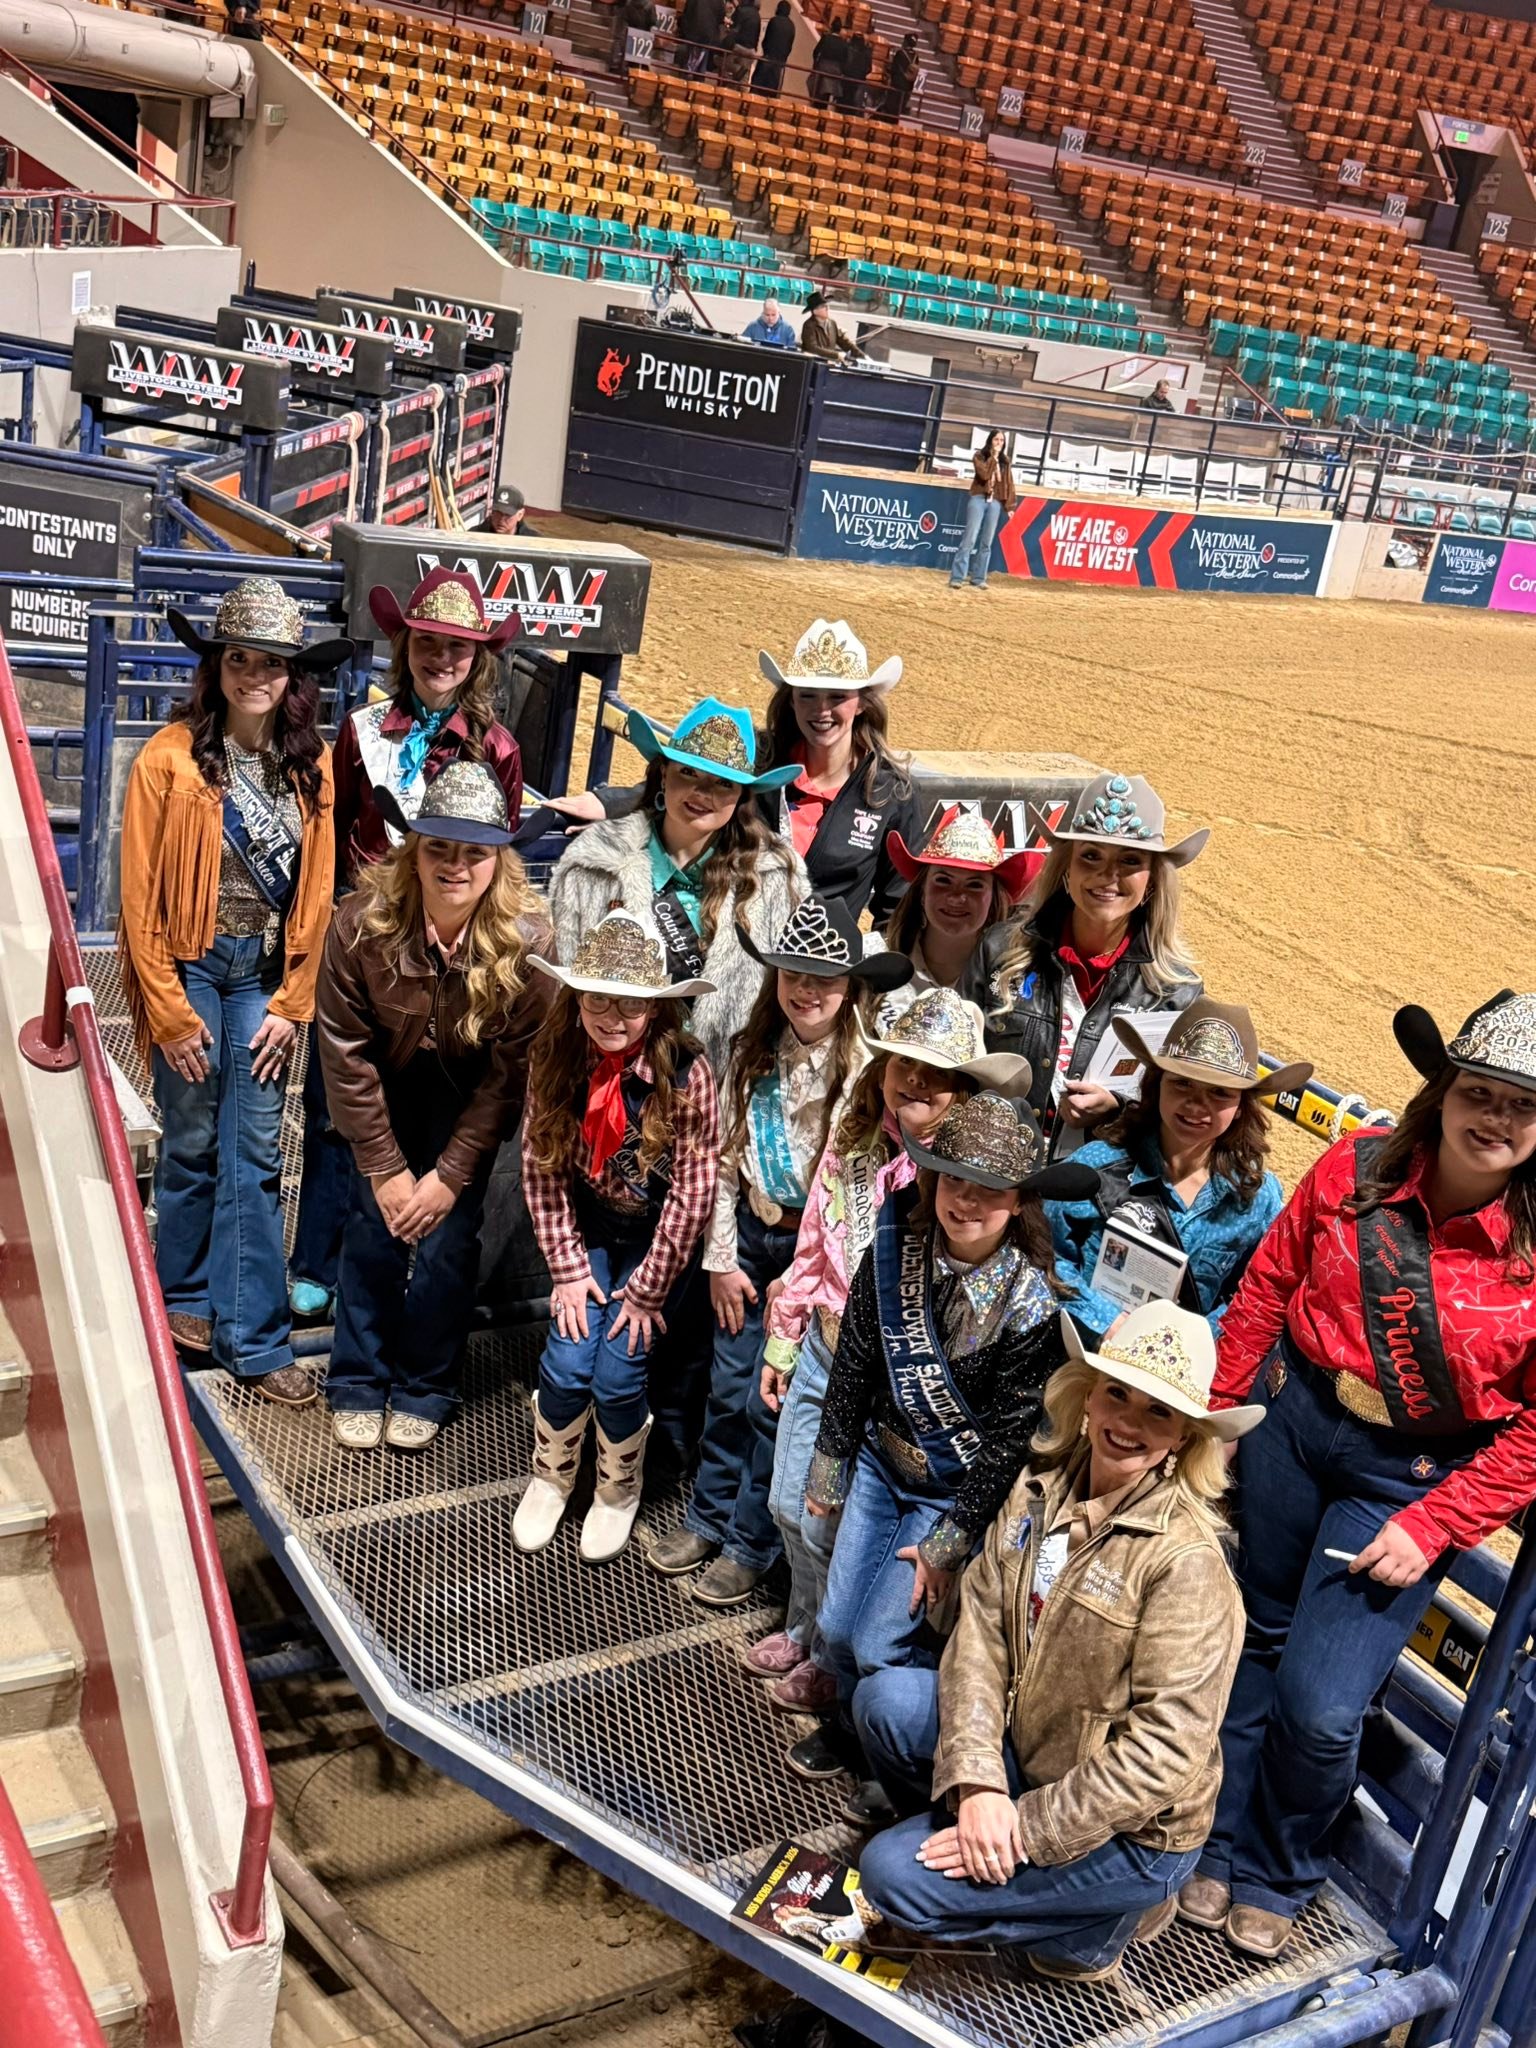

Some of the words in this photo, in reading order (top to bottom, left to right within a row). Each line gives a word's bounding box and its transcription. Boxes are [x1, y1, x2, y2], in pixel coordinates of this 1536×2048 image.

[530, 12, 547, 35] 121
[631, 36, 653, 59] 122
[1001, 93, 1022, 114] 223
[964, 111, 984, 133] 122
[1064, 133, 1085, 153] 123
[1245, 147, 1266, 165] 223
[1341, 166, 1363, 185] 224
[1387, 199, 1407, 218] 123
[1488, 219, 1510, 238] 125
[251, 342, 300, 357] LIVESTOCK
[302, 350, 342, 364] SYSTEMS
[394, 338, 425, 349] YSTEMS
[118, 369, 178, 387] LIVESTOCK
[181, 379, 230, 396] SYSTEMS
[635, 352, 782, 413] PENDLETON
[665, 394, 743, 420] WHISKY
[821, 489, 912, 518] NATIONAL
[0, 505, 117, 544] CONTESTANTS
[835, 512, 919, 541] WESTERN
[1050, 514, 1081, 541] WE
[1079, 517, 1115, 545] ARE
[32, 534, 77, 559] ONLY
[1190, 528, 1257, 551] NATIONAL
[1440, 543, 1485, 560] NATIONAL
[1053, 541, 1087, 567] THE
[1087, 543, 1138, 572] WEST
[1198, 548, 1261, 570] WESTERN
[1446, 556, 1487, 570] WESTERN
[11, 588, 91, 620] NUMBERS
[516, 603, 585, 618] SYSTEMS
[10, 611, 89, 641] REQUIRED
[655, 902, 689, 952] County
[1278, 1091, 1300, 1112] CAT
[851, 1154, 870, 1243] Crusaders
[1379, 1286, 1435, 1420] Princess
[896, 1363, 932, 1435] Princess
[916, 1363, 967, 1433] SADDLE
[1083, 1581, 1101, 1596] Utah
[1442, 1638, 1474, 1672] CAT
[753, 1883, 773, 1905] RODEO
[767, 1859, 791, 1887] AMERICA
